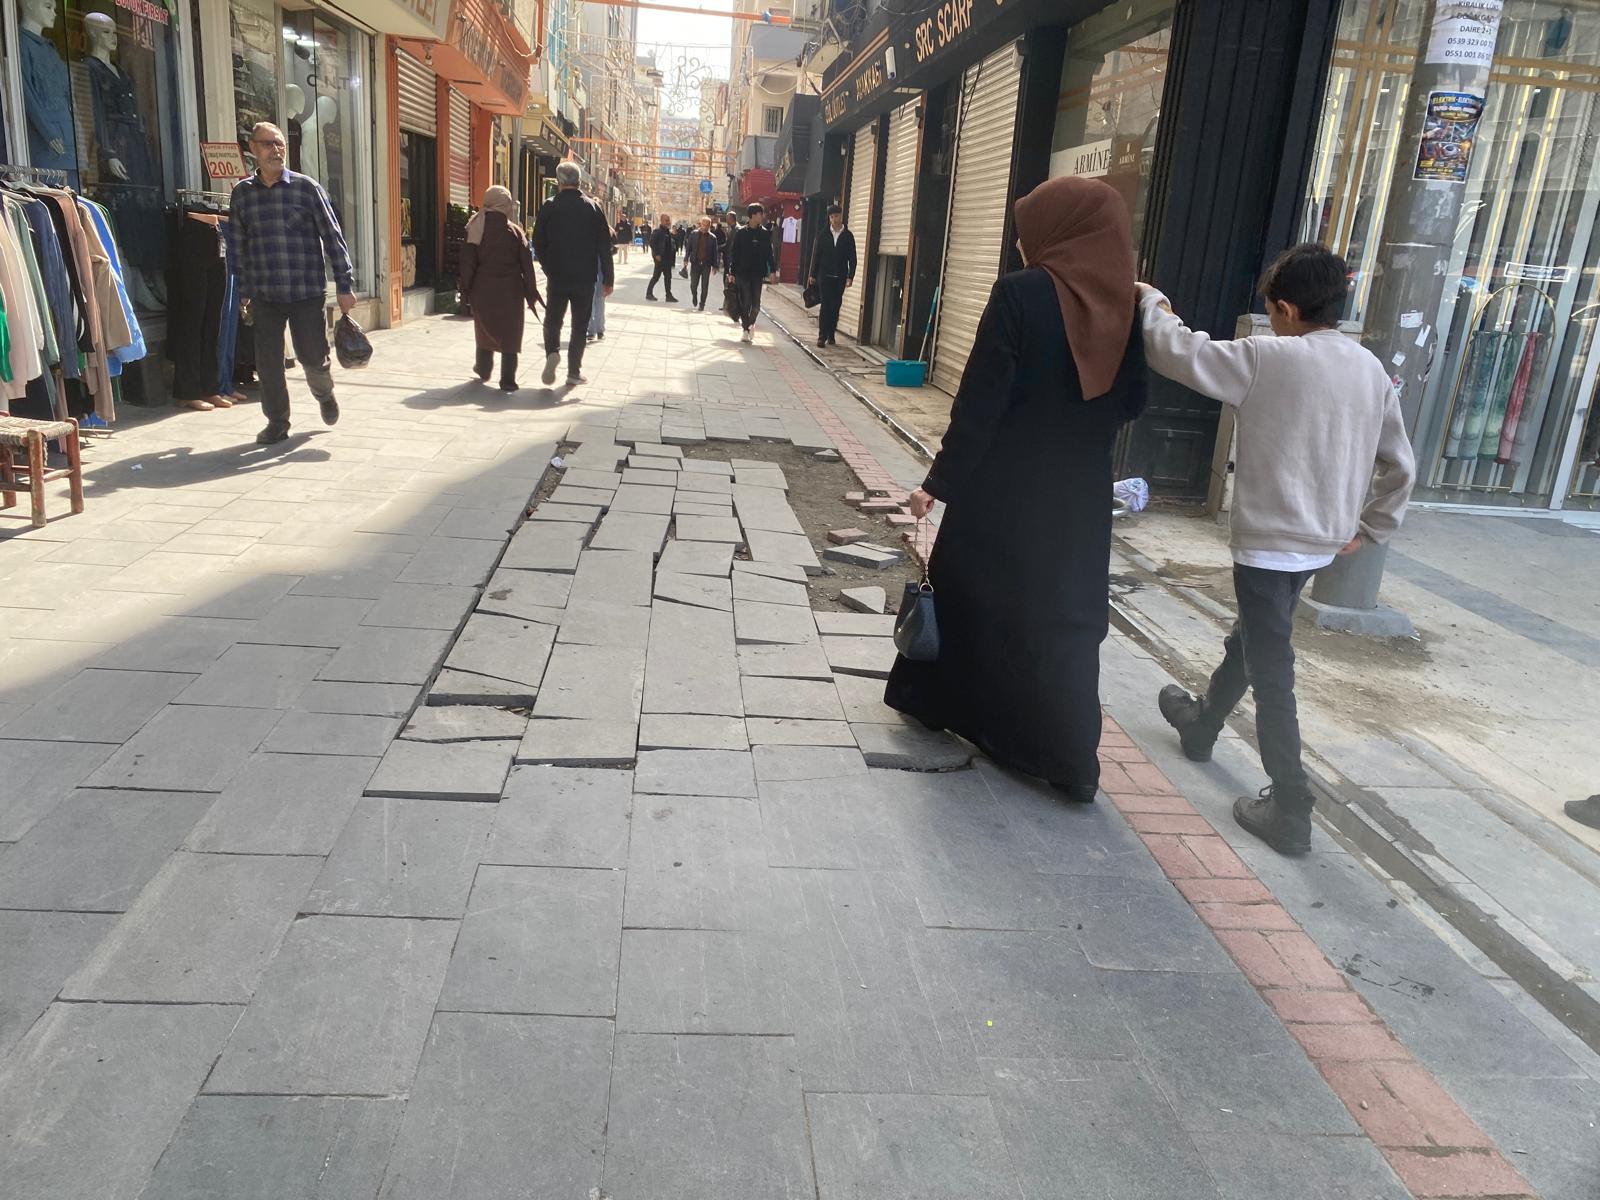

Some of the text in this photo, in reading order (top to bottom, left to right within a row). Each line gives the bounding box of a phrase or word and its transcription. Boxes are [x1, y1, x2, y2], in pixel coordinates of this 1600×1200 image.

[915, 17, 934, 63] SRC
[1447, 37, 1466, 45] 0539
[1466, 38, 1479, 46] 323
[1073, 146, 1112, 175] ARMİNE
